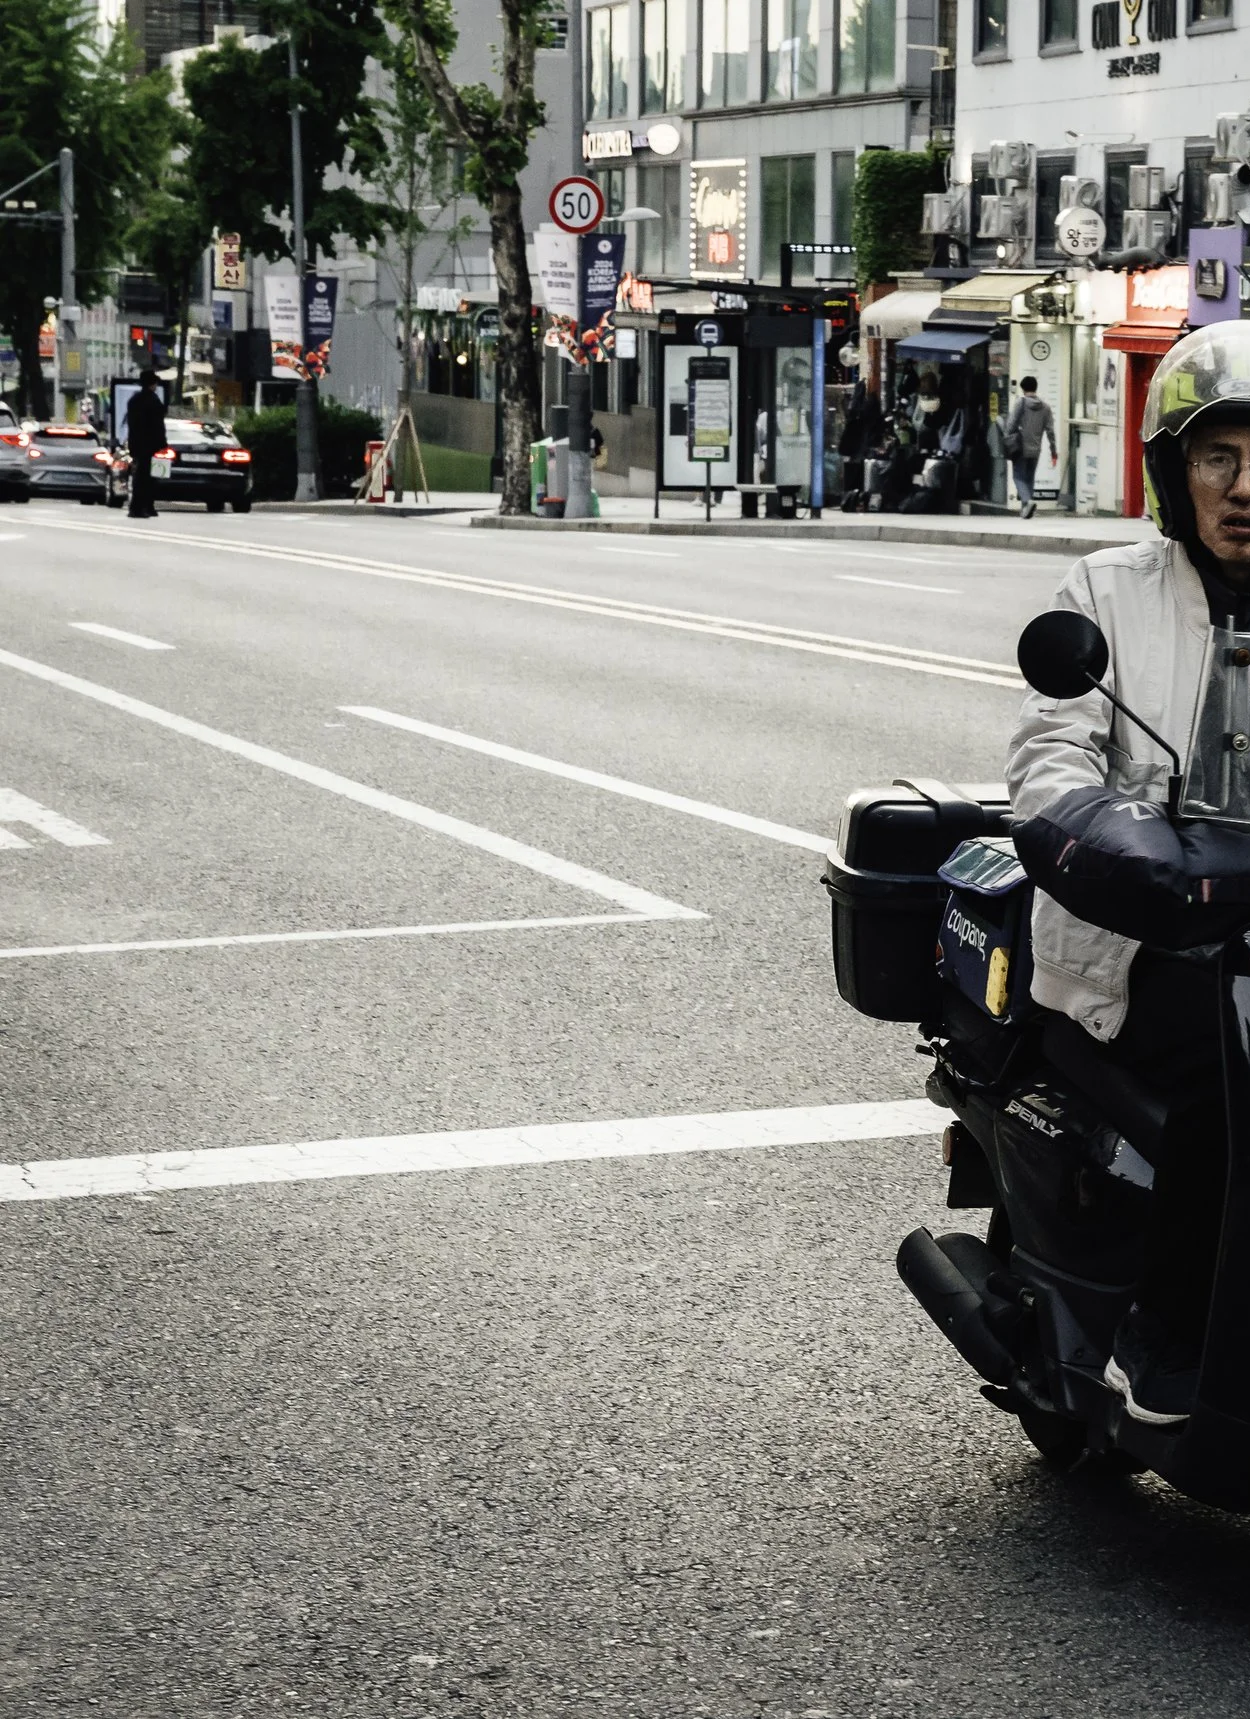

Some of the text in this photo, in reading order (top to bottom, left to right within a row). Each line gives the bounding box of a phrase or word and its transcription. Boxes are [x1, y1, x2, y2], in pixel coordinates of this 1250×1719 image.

[562, 192, 591, 220] 50
[1066, 229, 1081, 248] 왕
[1004, 1099, 1064, 1138] BENLY
